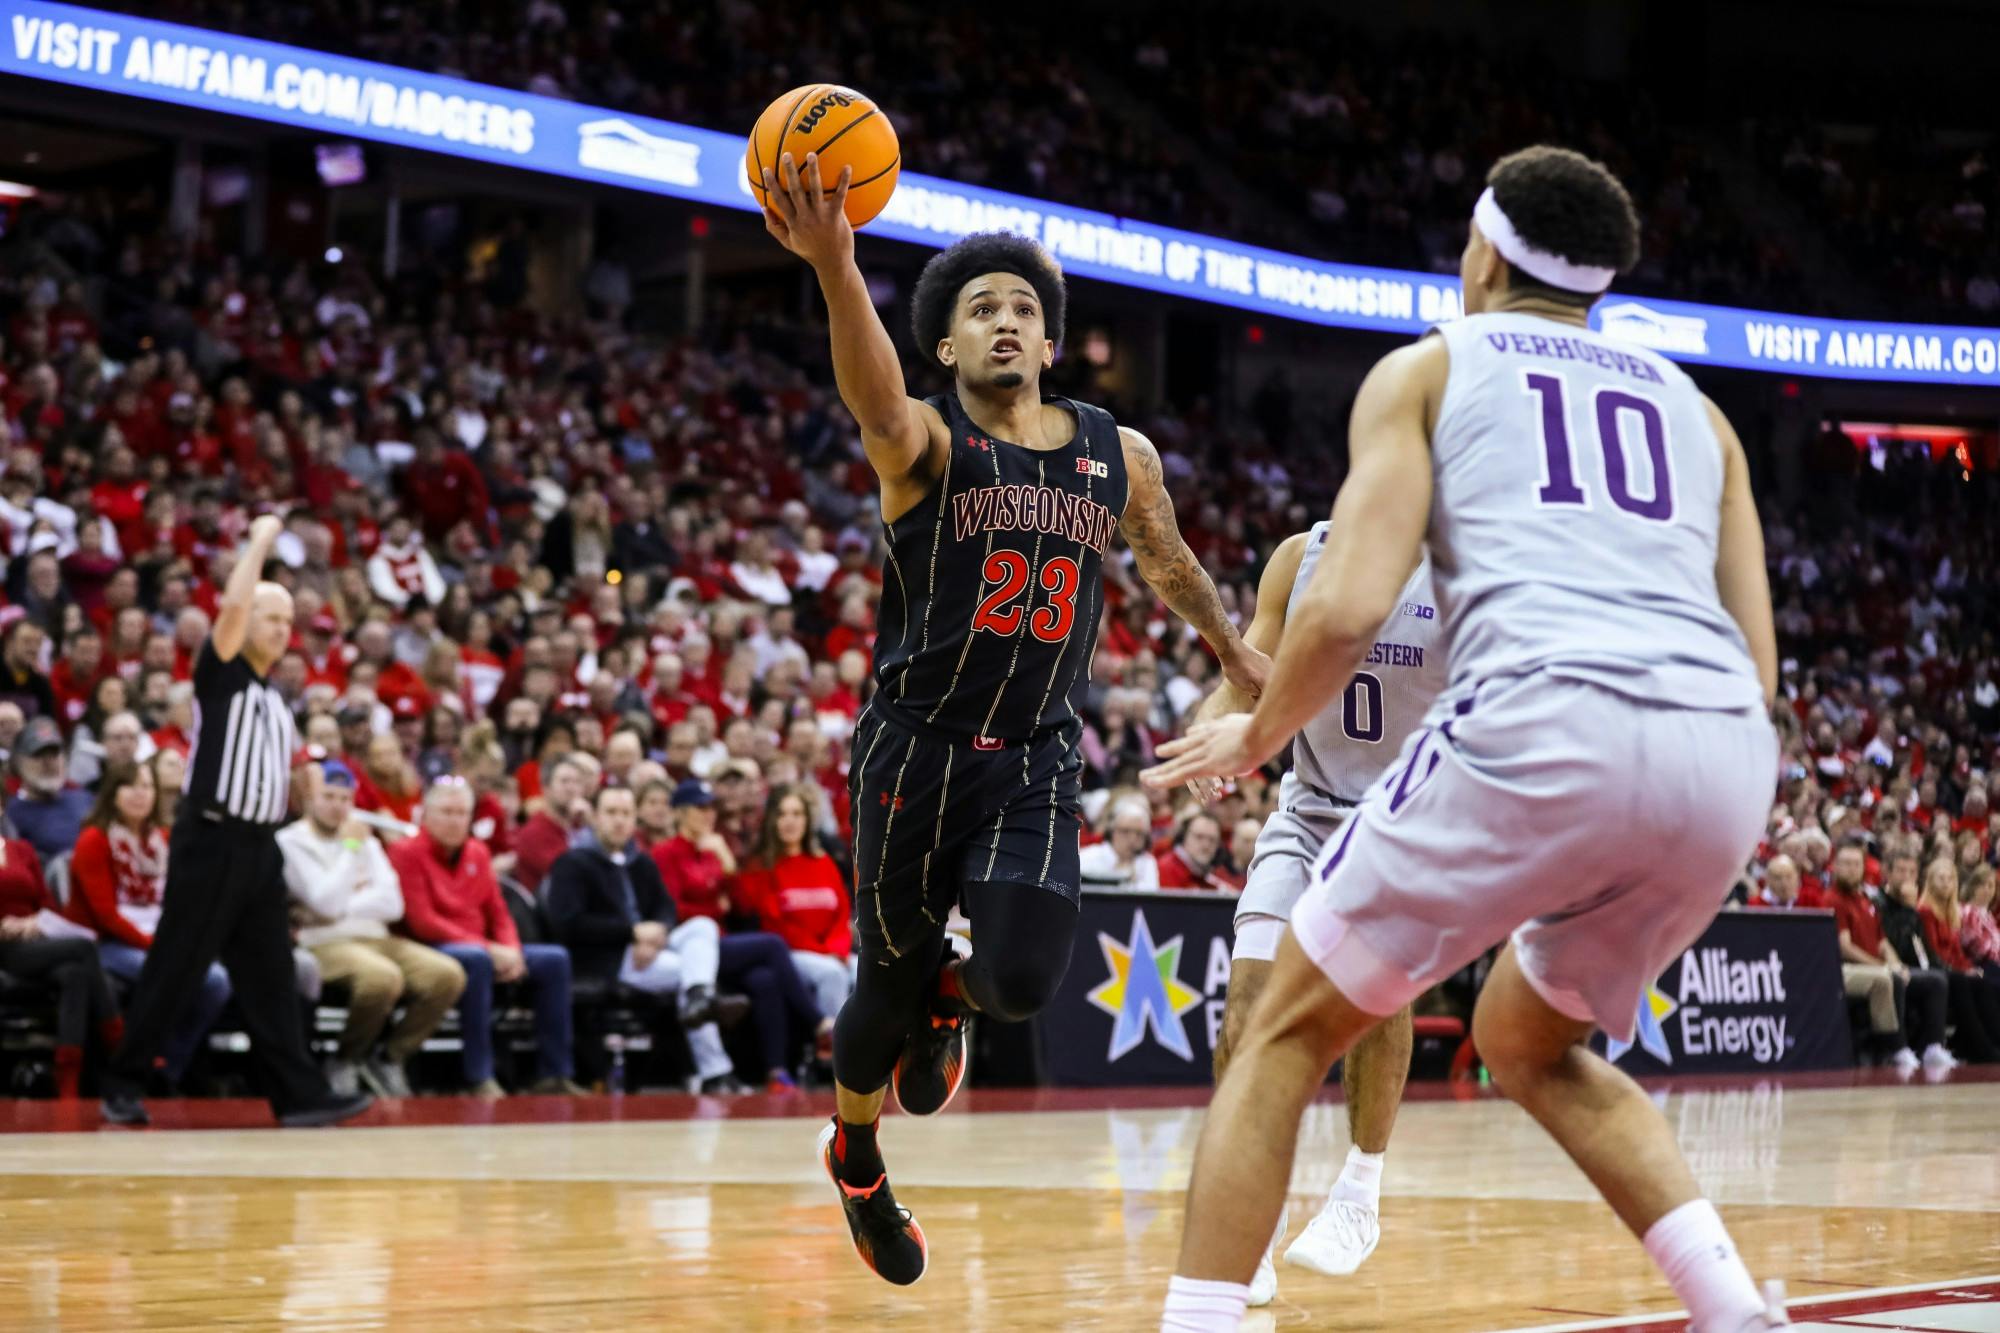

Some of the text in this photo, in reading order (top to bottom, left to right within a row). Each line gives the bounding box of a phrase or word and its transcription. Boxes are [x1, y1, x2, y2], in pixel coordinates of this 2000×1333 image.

[12, 15, 534, 153] VISIT AMFAM.COM/BADGERS
[1044, 214, 1163, 277] PARTNER
[1165, 240, 1201, 283] OF
[1203, 248, 1254, 294] THE
[1255, 260, 1413, 319] WISCONSIN
[1487, 332, 1666, 386] VERHOEVEN
[1744, 321, 1821, 364] VISIT
[1825, 330, 2000, 375] AMFAM.CO
[1520, 368, 1678, 525] 10
[952, 485, 1117, 562] WISCONSIN
[971, 548, 1080, 643] 23
[1341, 670, 1384, 744] 0
[1679, 947, 1787, 1004] Alliant
[1680, 1006, 1787, 1064] Energy
